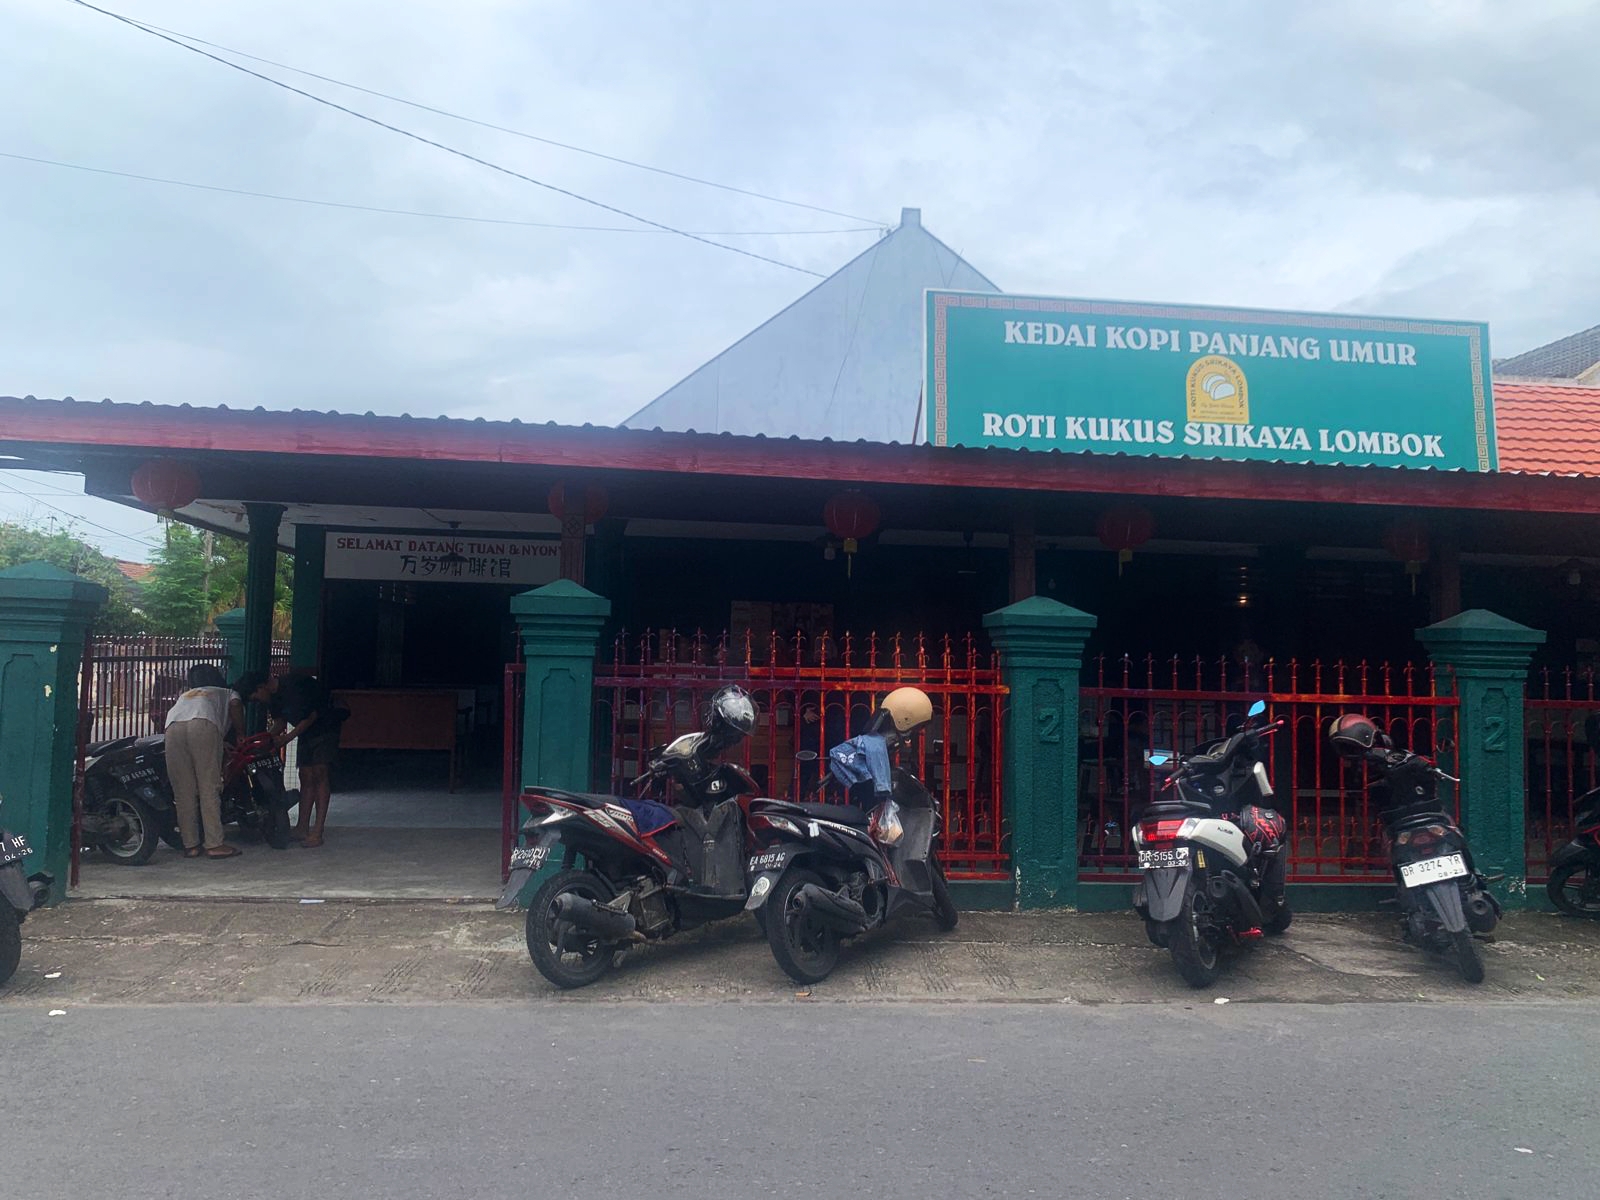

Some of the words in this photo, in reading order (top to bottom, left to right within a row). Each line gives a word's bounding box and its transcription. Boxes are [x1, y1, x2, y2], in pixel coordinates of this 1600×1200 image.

[1004, 320, 1096, 348] KEDAI
[1106, 325, 1181, 353] KOPI
[1189, 330, 1320, 361] PANJANG
[1329, 339, 1417, 366] UMUR
[982, 412, 1056, 439] ROTI
[1066, 416, 1174, 444] KUKUS
[1183, 421, 1312, 451] SRIKAYA
[1319, 429, 1445, 458] LOMBOK
[337, 537, 403, 550] SELAMAT
[408, 540, 464, 553] DATANG
[467, 543, 505, 555] TUAN
[509, 544, 520, 555] &
[521, 546, 562, 557] NYON
[1039, 708, 1061, 743] 2
[1484, 716, 1506, 752] 2
[11, 835, 25, 848] HF
[1141, 852, 1152, 862] DR
[1153, 851, 1173, 862] 5155
[1403, 866, 1415, 877] DR
[1418, 860, 1442, 873] 3274
[1447, 855, 1461, 865] YR
